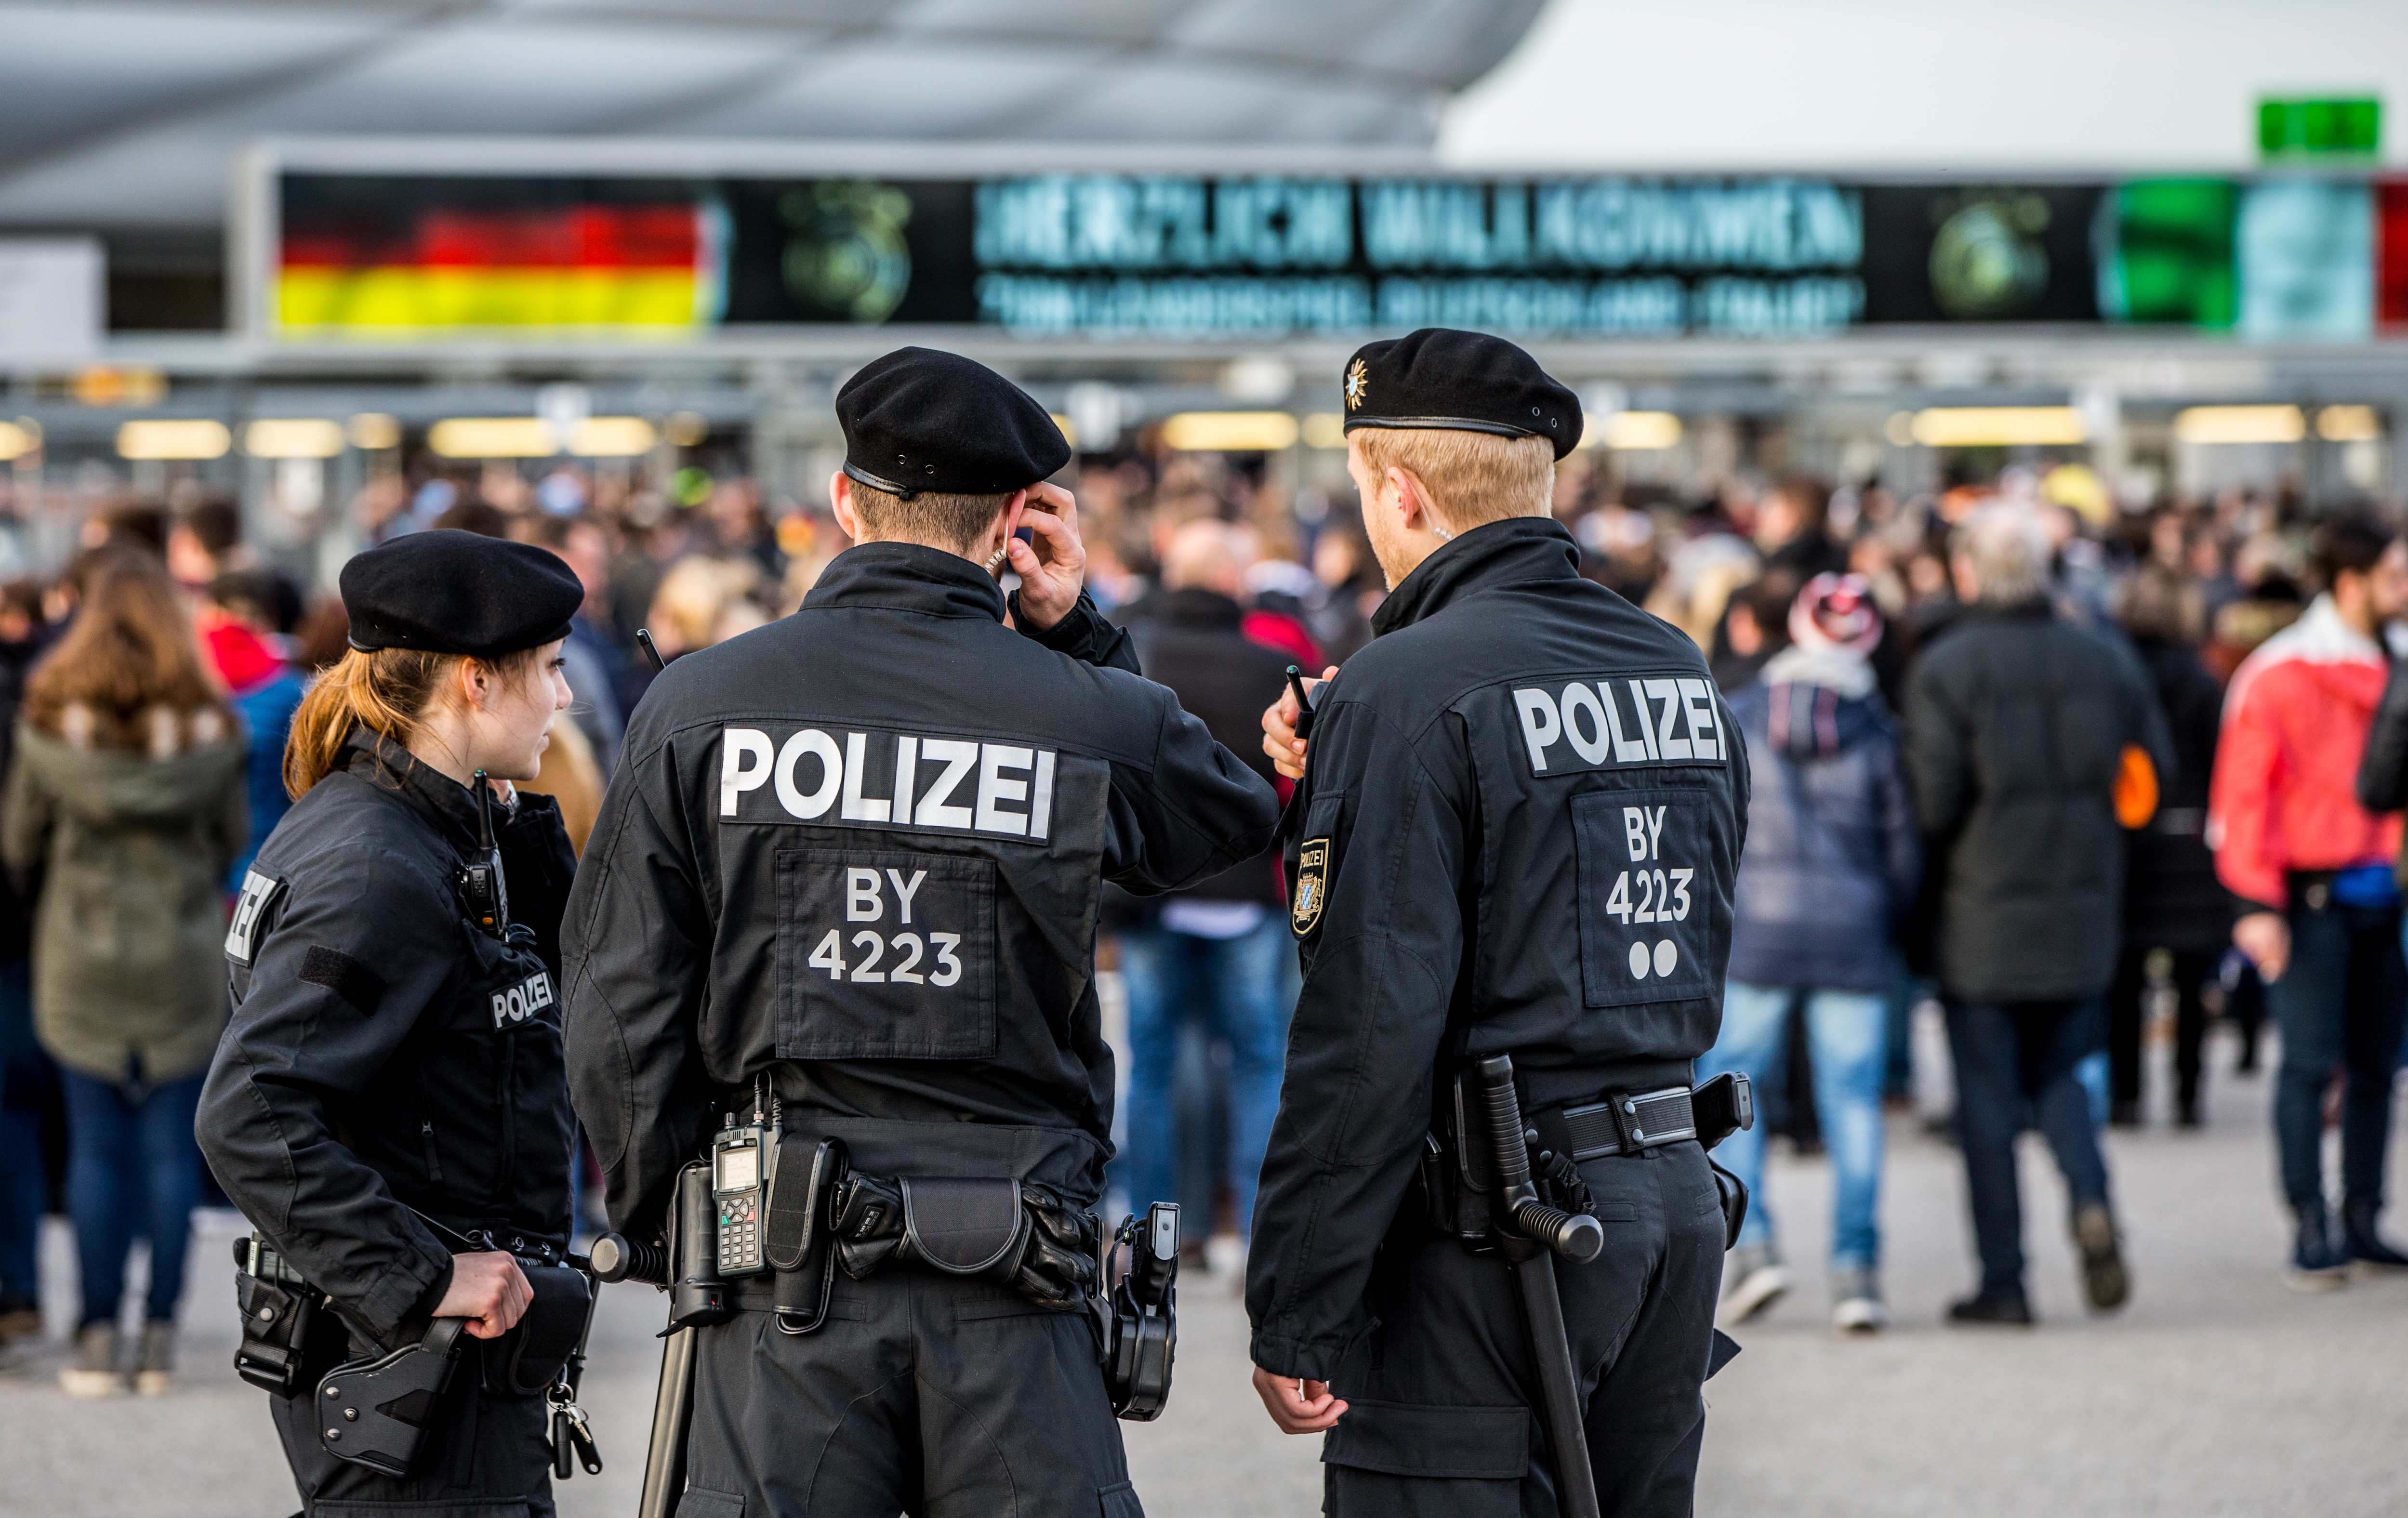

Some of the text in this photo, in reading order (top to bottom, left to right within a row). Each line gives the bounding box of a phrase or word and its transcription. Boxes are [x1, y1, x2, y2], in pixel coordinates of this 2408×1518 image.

[1513, 679, 1727, 771] POLIZEI
[720, 728, 1056, 839] POLIZEI
[1623, 805, 1667, 861] BY
[847, 868, 927, 924] BY
[1606, 868, 1694, 924] 4223
[808, 929, 962, 987] 4223
[492, 972, 554, 1028] POLIZEI
